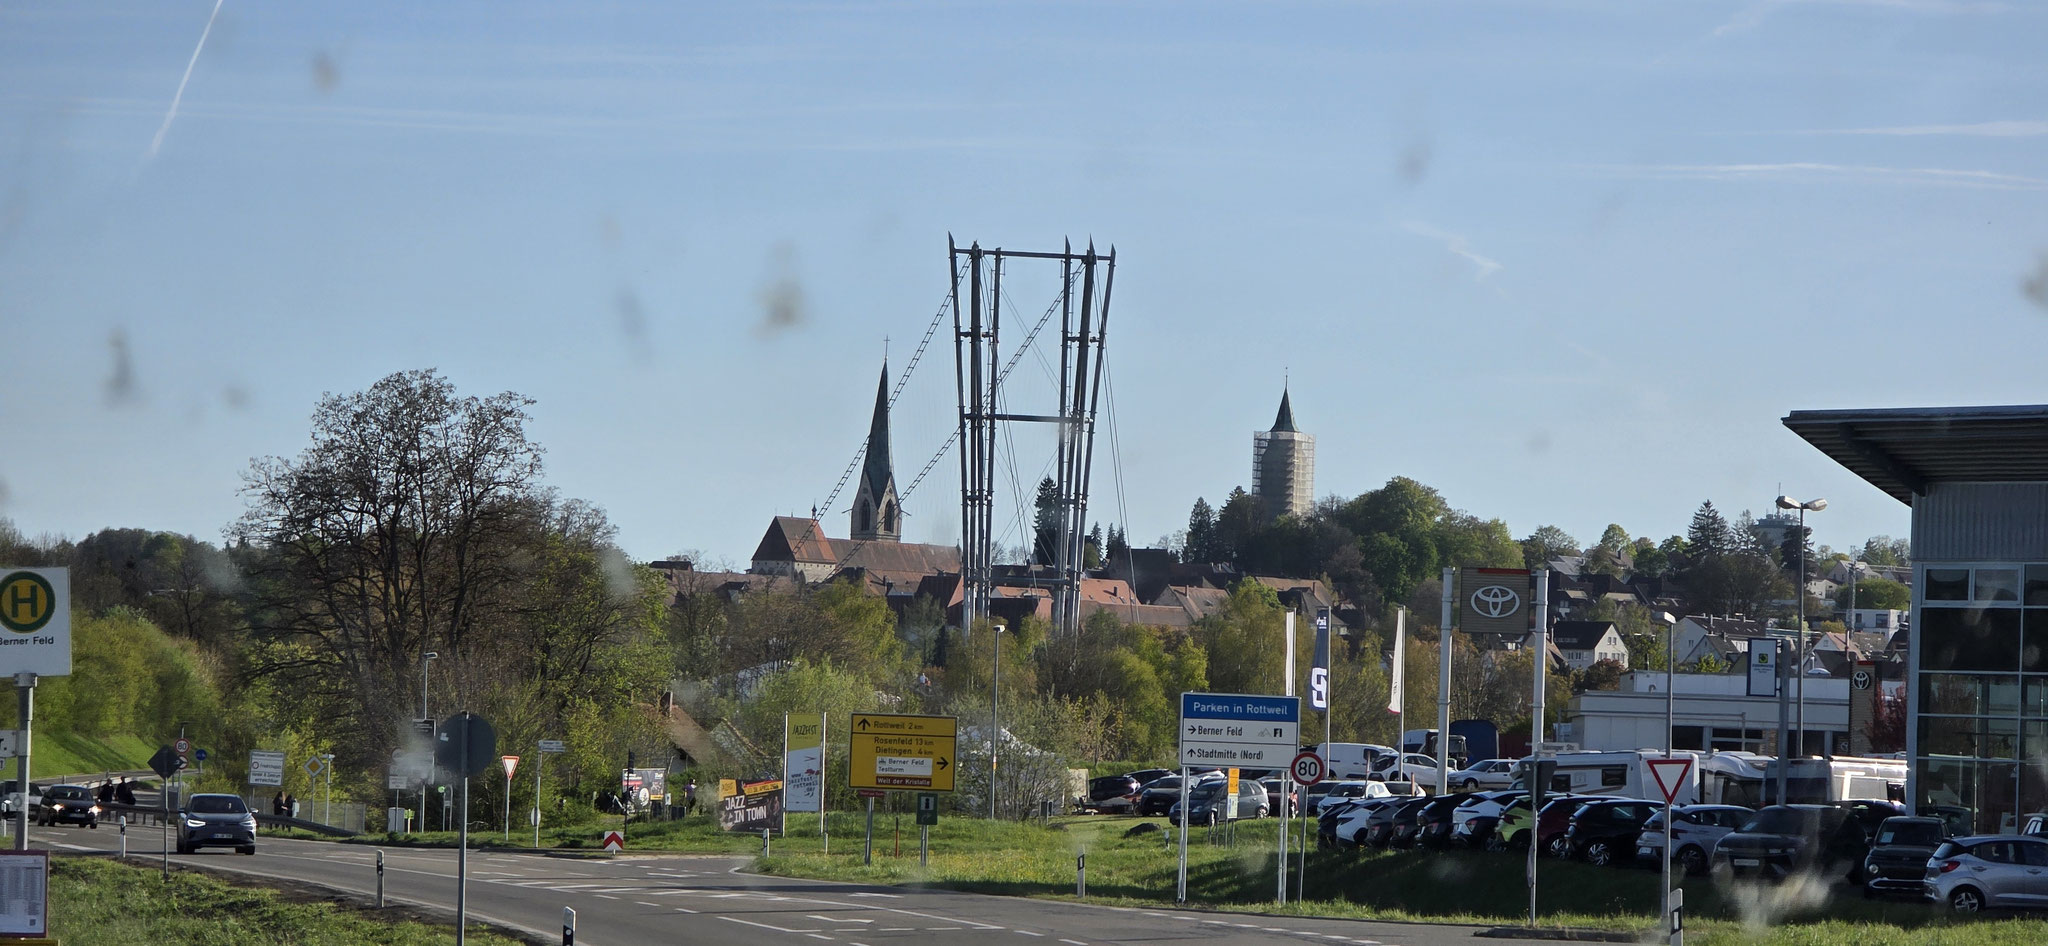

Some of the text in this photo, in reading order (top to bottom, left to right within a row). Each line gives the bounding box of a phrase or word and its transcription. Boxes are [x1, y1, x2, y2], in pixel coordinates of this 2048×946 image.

[33, 636, 54, 644] Feld
[1193, 702, 1288, 715] Parken in Rottweil
[874, 720, 904, 730] Rottweil
[1198, 726, 1242, 736] Berner Feld
[874, 736, 912, 745] Rosenfeld
[876, 746, 912, 756] Dietingen
[1197, 749, 1264, 760] Stadtmitte (Nord)
[1298, 762, 1318, 777] 80
[725, 795, 745, 810] JAZZ
[734, 806, 766, 823] IN TOWN
